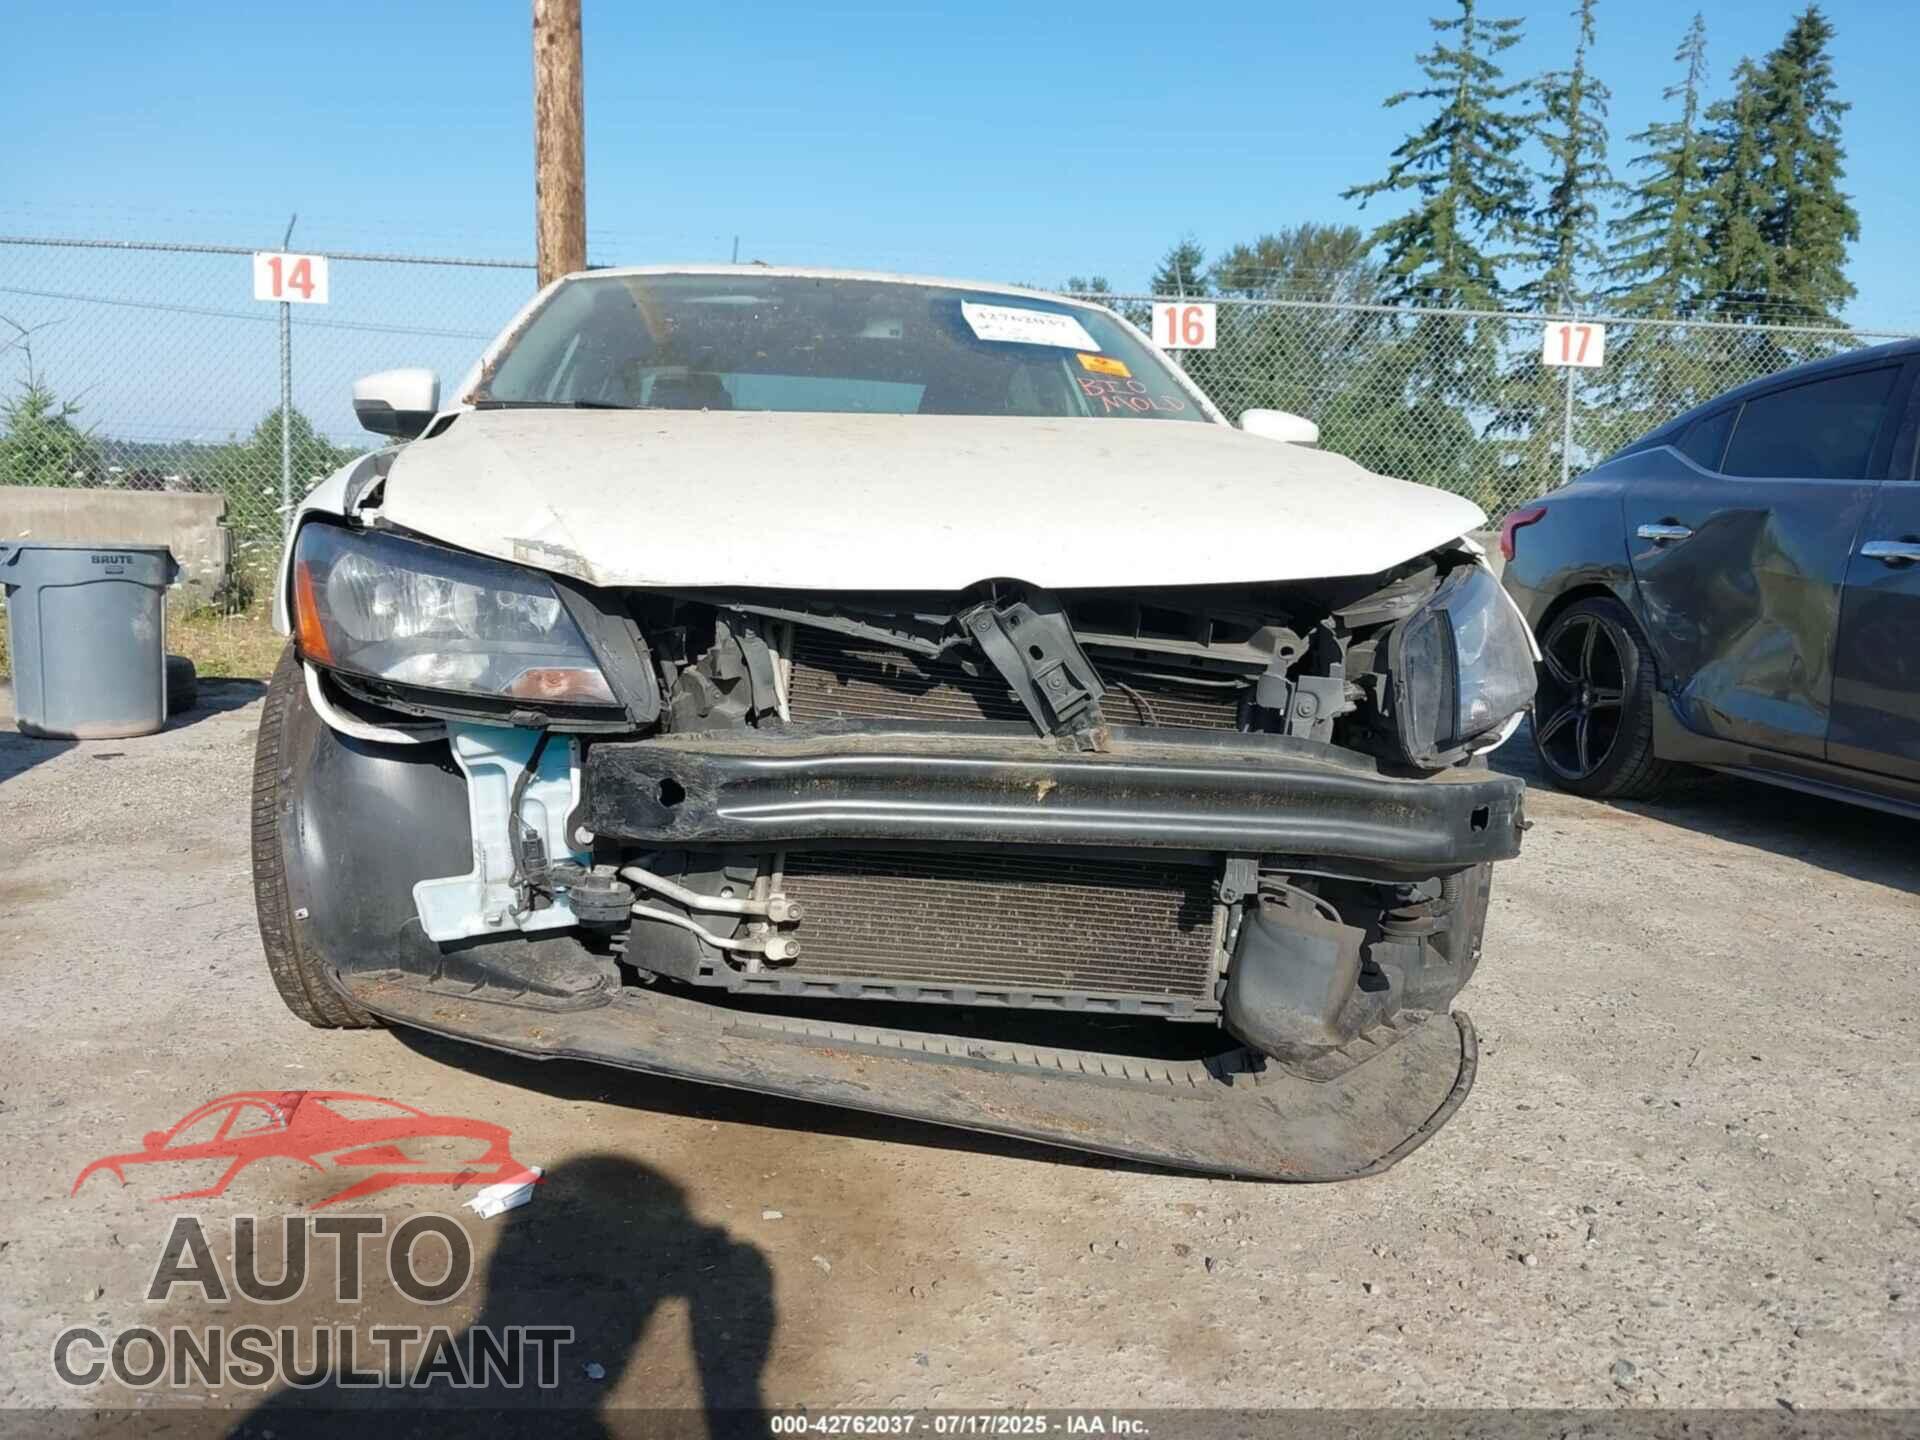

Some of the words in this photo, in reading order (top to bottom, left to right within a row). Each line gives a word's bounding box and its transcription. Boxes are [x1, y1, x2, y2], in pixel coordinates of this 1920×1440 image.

[267, 256, 315, 298] 14
[1165, 306, 1205, 345] 16
[1559, 325, 1591, 362] 17
[1101, 394, 1185, 414] MOLD
[91, 555, 134, 564] BRUTE
